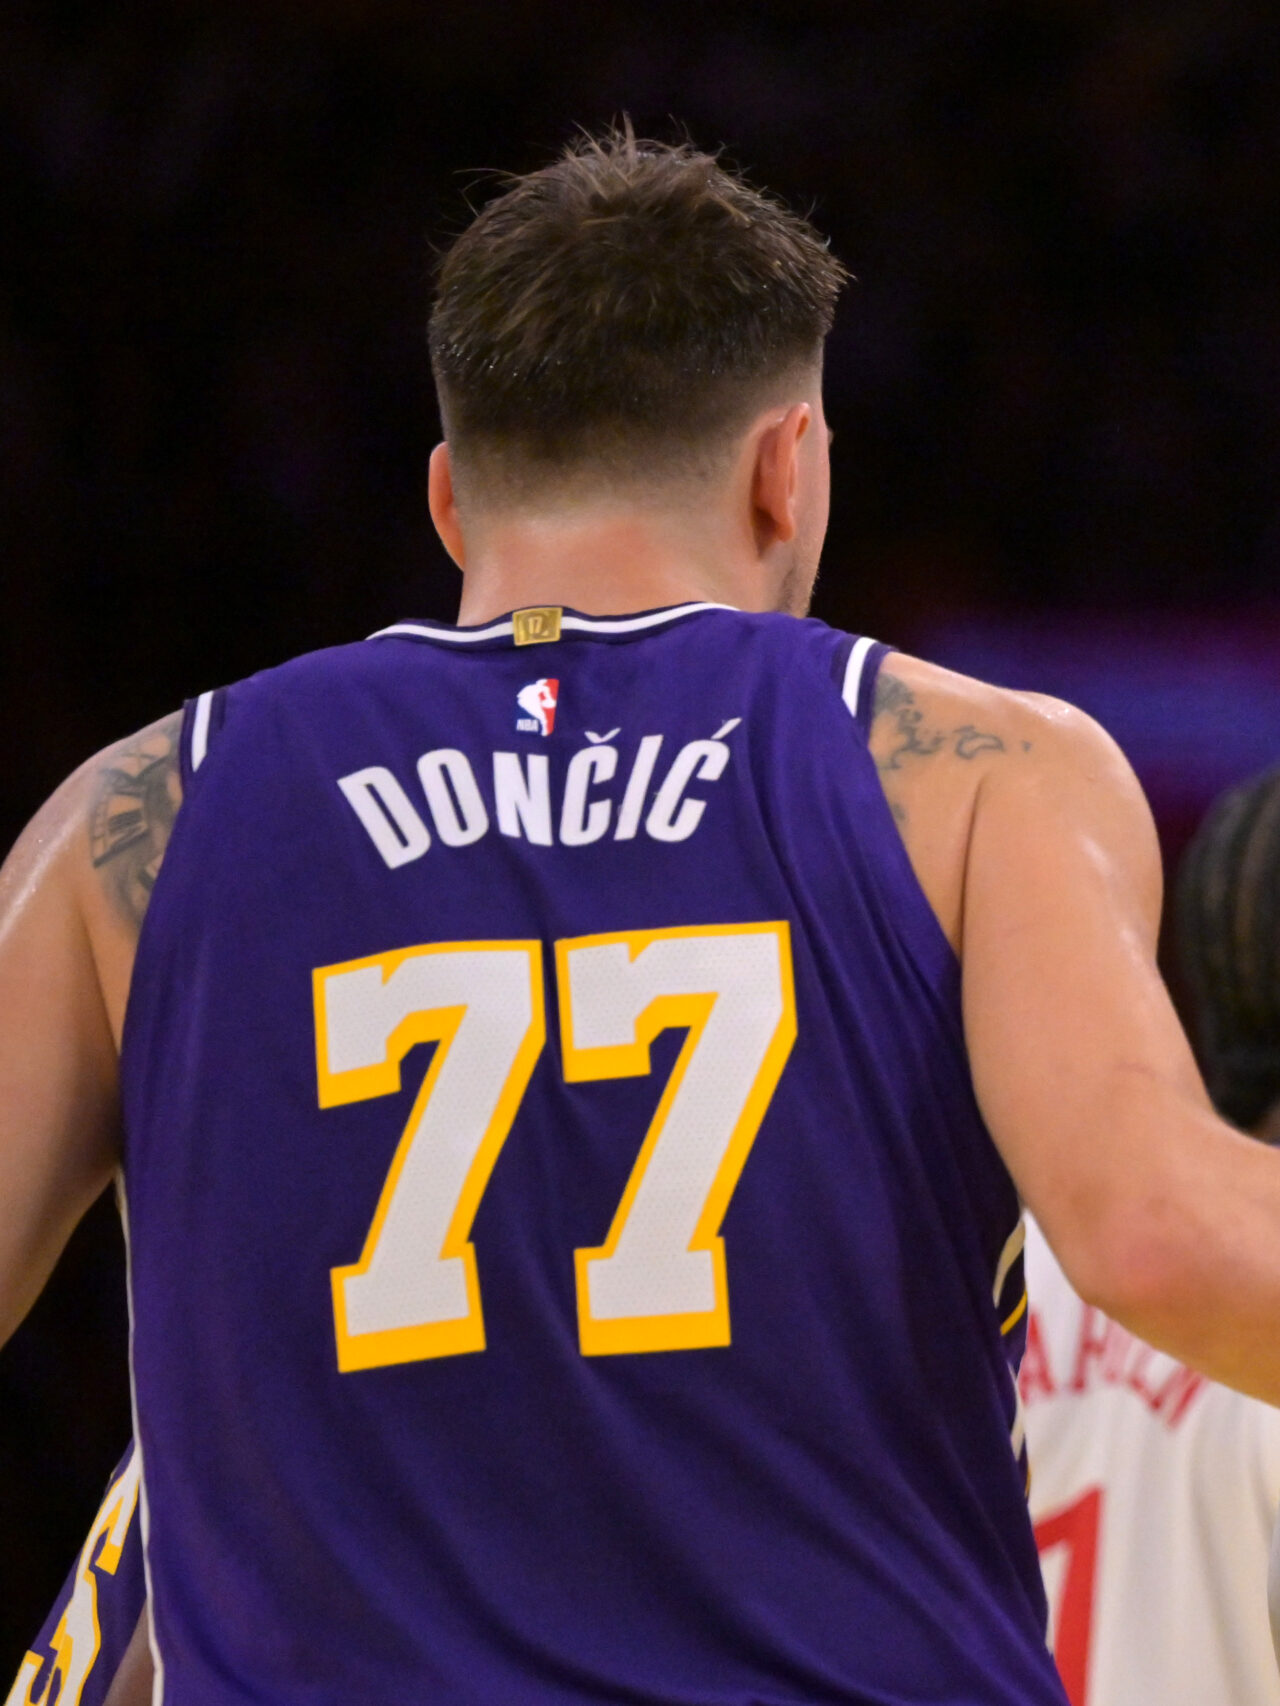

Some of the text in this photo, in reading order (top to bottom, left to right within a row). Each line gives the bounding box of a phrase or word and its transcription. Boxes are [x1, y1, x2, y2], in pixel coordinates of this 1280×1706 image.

[337, 717, 742, 870] DONČIĆ
[516, 718, 539, 732] NBA
[312, 920, 798, 1373] 77
